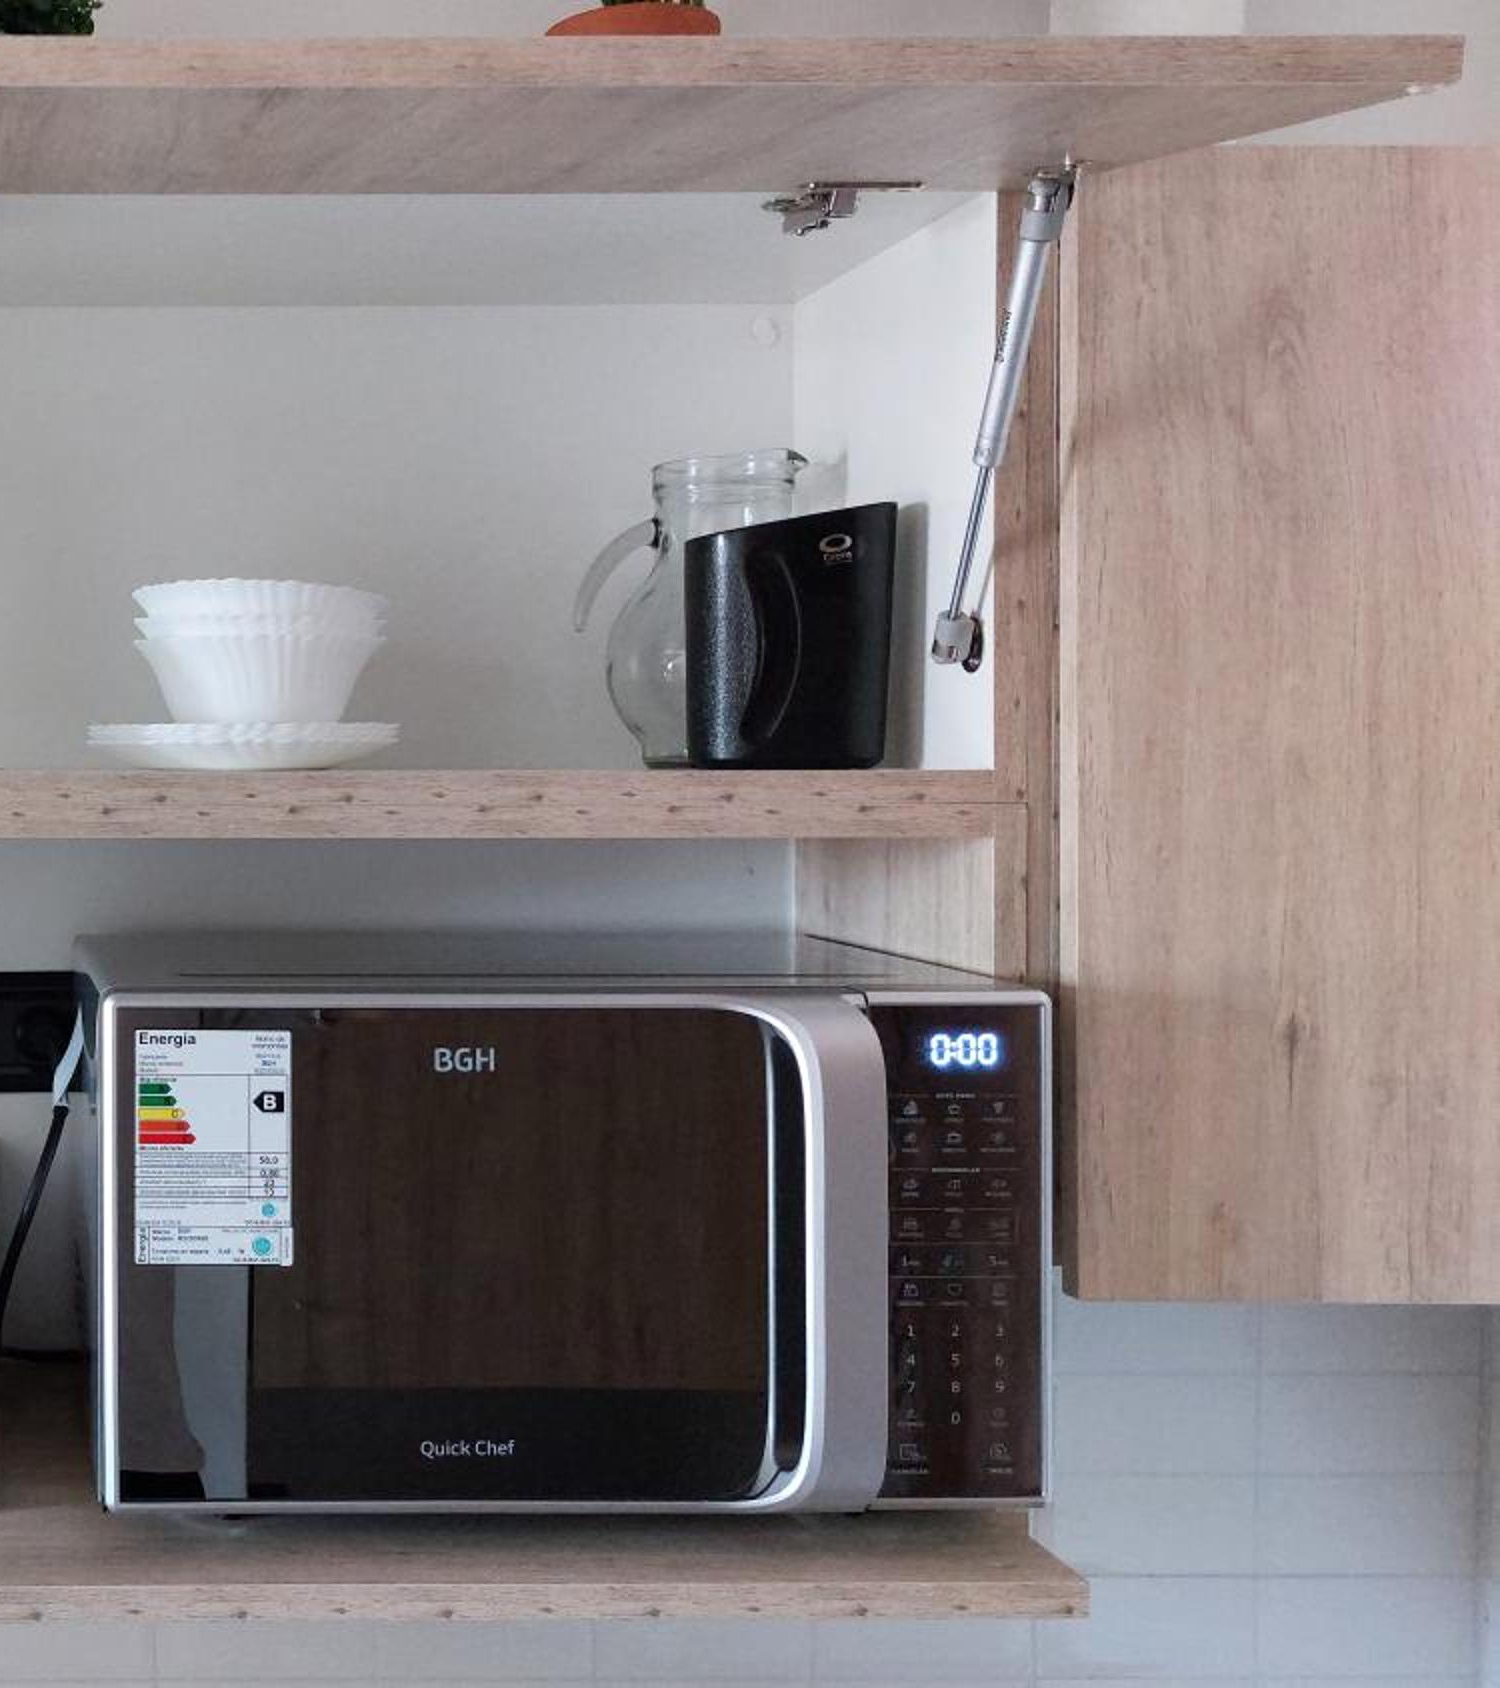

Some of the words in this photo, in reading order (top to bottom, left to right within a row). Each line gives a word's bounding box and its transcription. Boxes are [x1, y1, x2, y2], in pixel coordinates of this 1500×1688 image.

[929, 1032, 999, 1067] 0:00
[433, 1046, 496, 1073] BGH
[263, 1093, 278, 1111] B
[907, 1324, 916, 1337] 1
[951, 1324, 960, 1337] 2
[906, 1354, 916, 1366] 4
[951, 1353, 961, 1366] 5
[907, 1381, 916, 1393] 7
[420, 1439, 471, 1459] Quick
[475, 1439, 516, 1456] Chef
